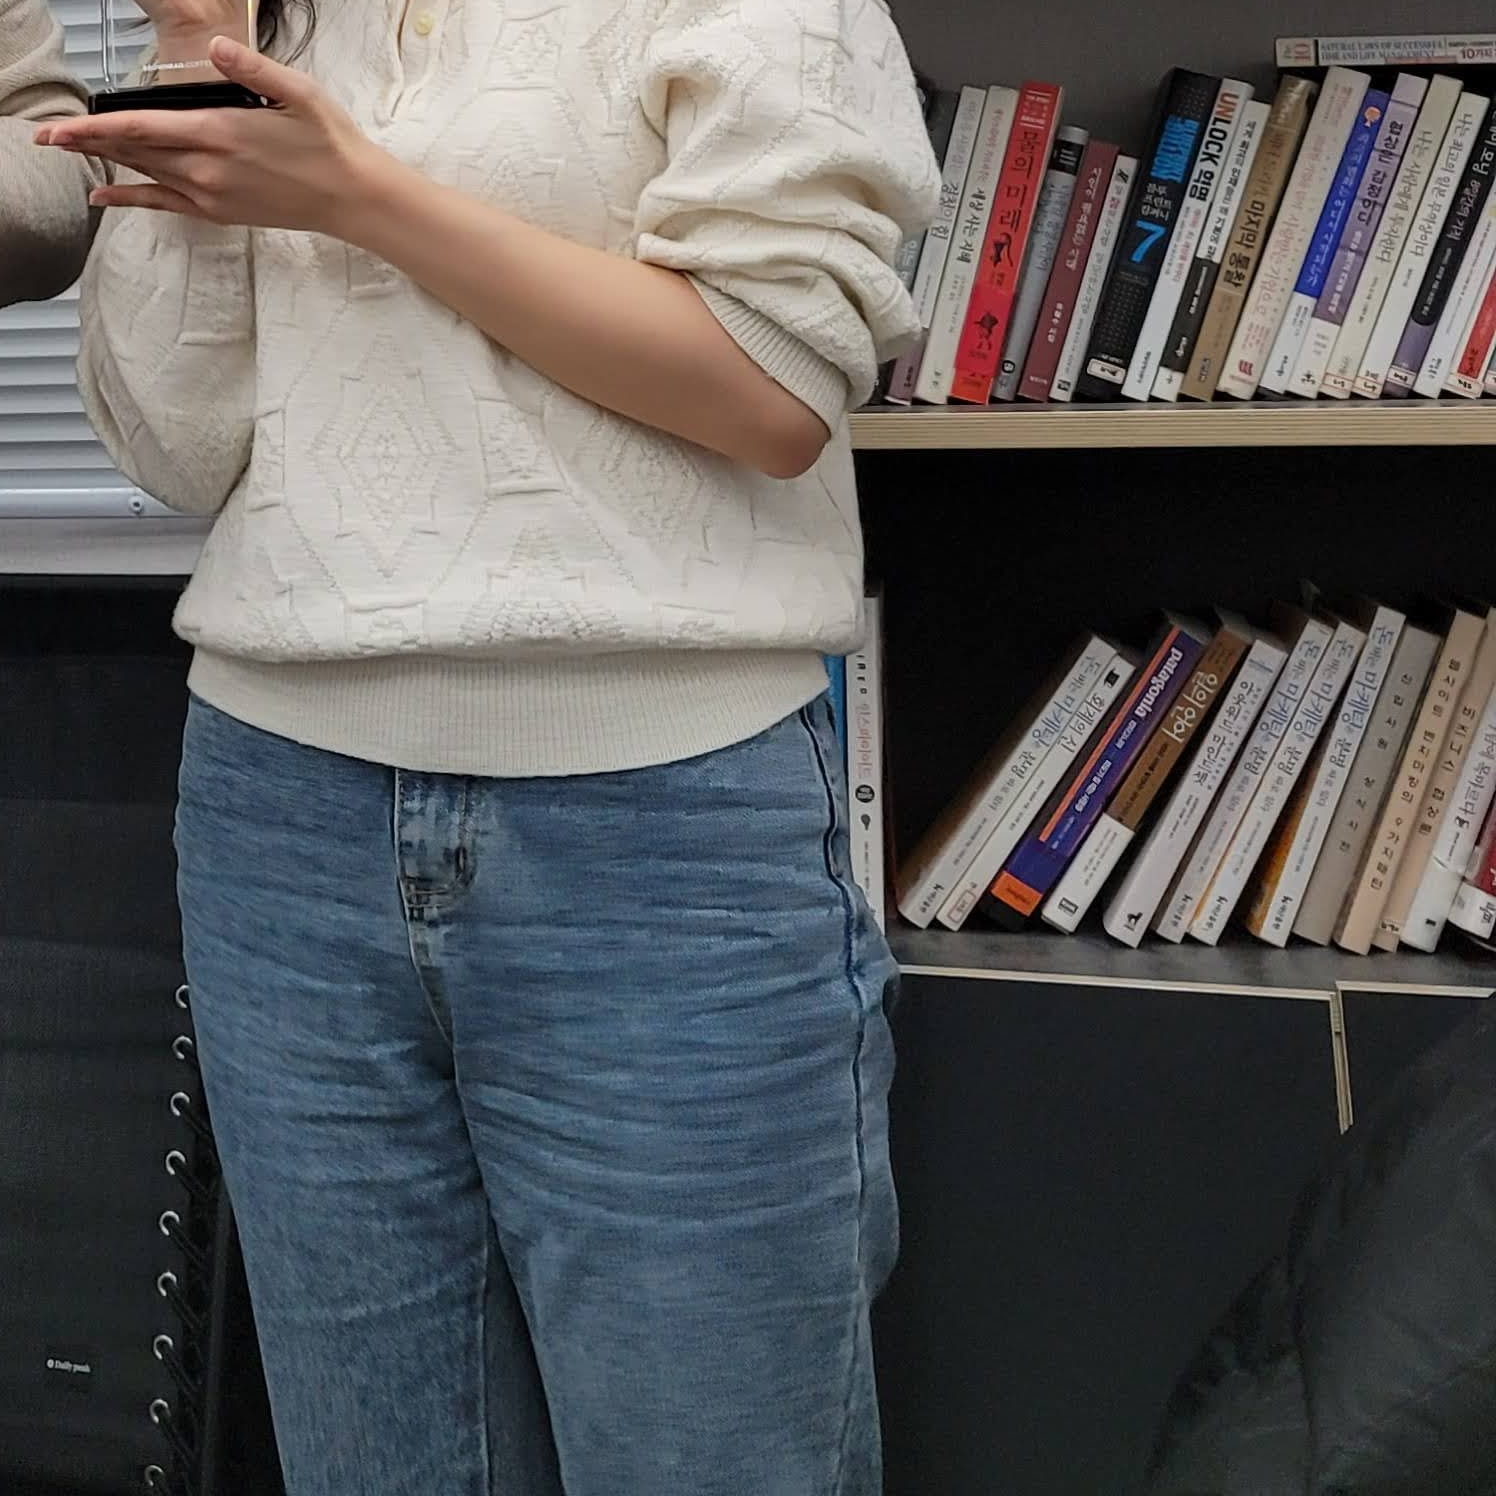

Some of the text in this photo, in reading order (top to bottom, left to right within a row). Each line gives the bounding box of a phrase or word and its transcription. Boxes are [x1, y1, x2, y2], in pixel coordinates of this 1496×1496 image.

[1188, 89, 1238, 202] UNLOCK 익명
[1453, 110, 1475, 138] 나는
[1471, 145, 1494, 175] 모닝
[1354, 167, 1386, 225] 감정이다
[1373, 128, 1434, 264] 나는 사람에게 투자한다
[1432, 173, 1451, 197] 일본
[956, 186, 986, 264] 세상 사는 지혜
[1126, 220, 1165, 266] 7
[1223, 197, 1266, 288] 마지막 통찰
[1446, 217, 1466, 241] 기적
[1371, 624, 1396, 649] 돈
[1131, 646, 1185, 720] patagonia
[1160, 666, 1220, 743] 일의 언어
[1055, 690, 1107, 755] 회계의 신
[1242, 744, 1269, 776] 분명
[1276, 744, 1302, 776] 분명
[1328, 735, 1355, 768] 분명
